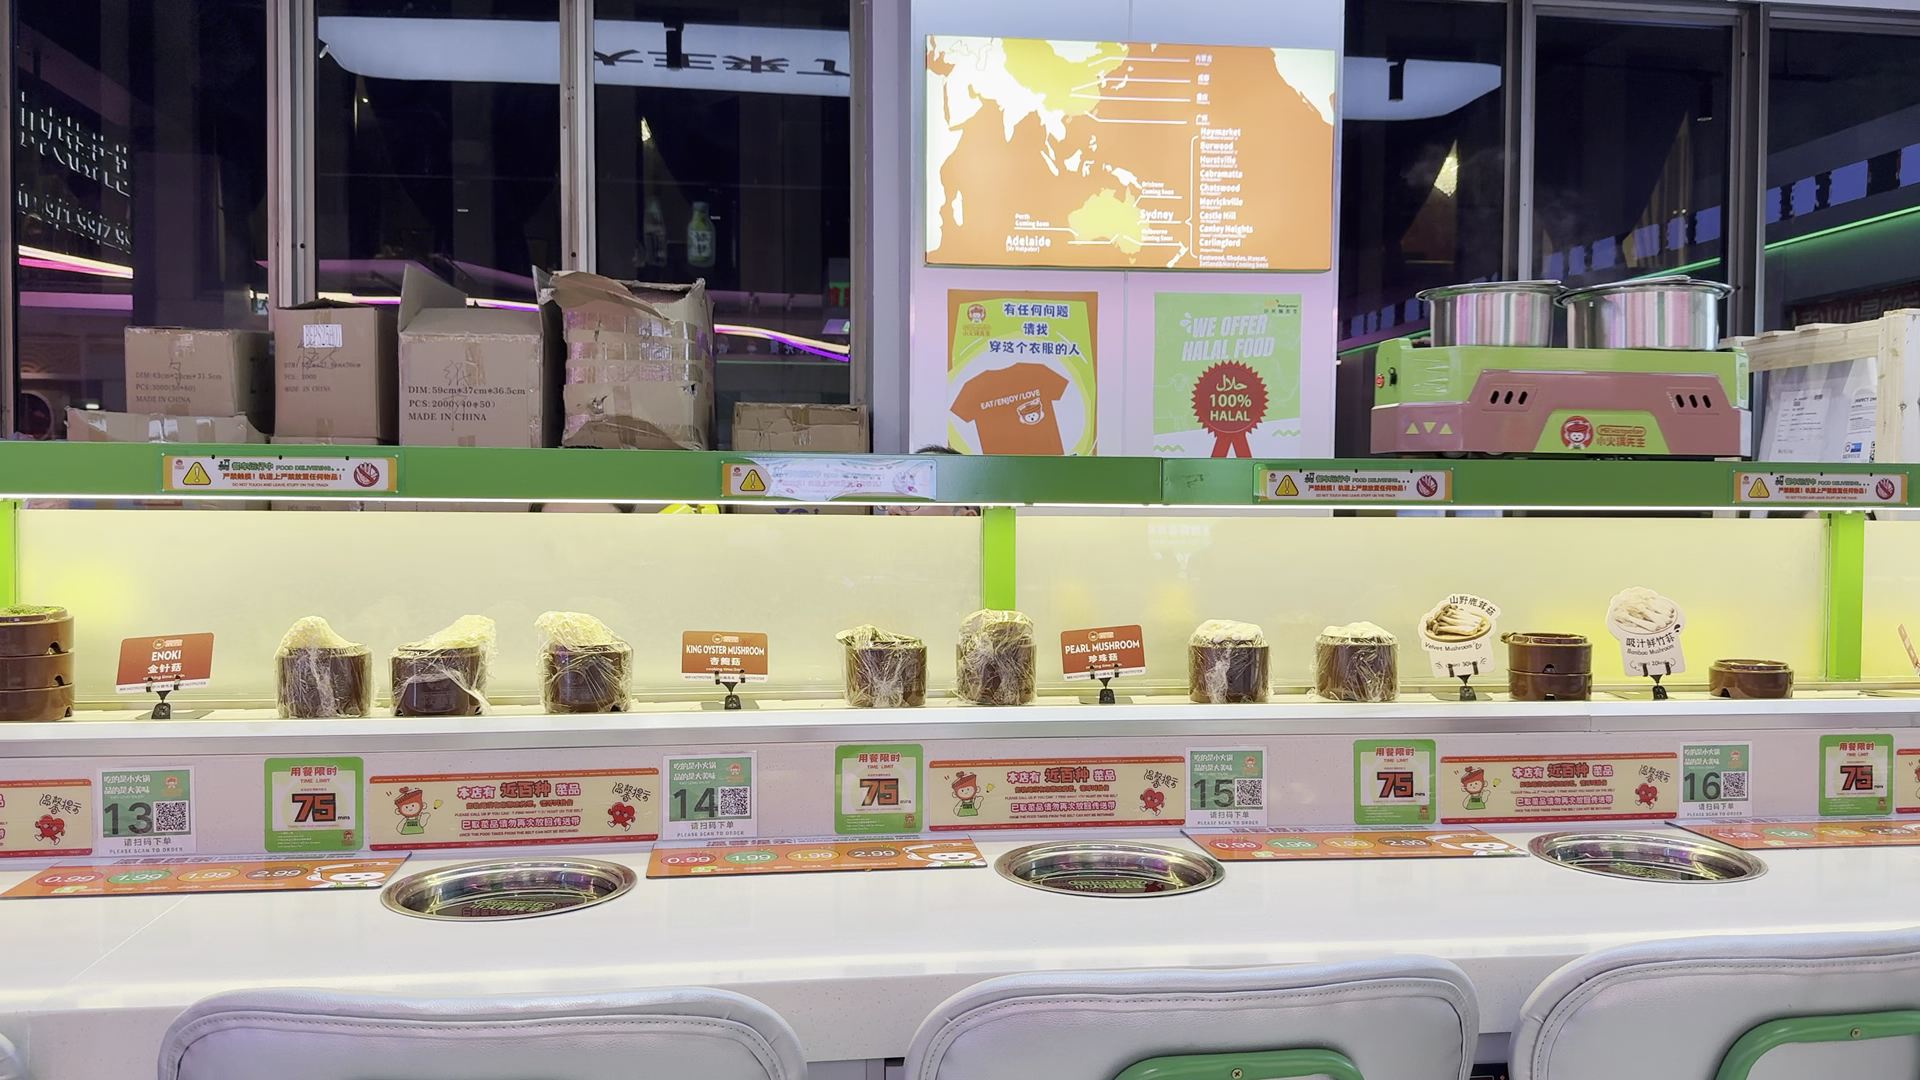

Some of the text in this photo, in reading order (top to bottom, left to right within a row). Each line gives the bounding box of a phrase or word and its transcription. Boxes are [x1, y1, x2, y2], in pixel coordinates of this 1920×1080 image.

[1200, 128, 1241, 138] Haymarket
[1200, 141, 1234, 150] Burwood
[1200, 155, 1236, 164] Hurstville
[1200, 169, 1243, 178] Cabramatta
[1142, 188, 1161, 196] Coming
[1200, 183, 1241, 192] Chatswood
[1200, 197, 1243, 206] Marrickville
[1140, 209, 1173, 221] Sydney
[1200, 211, 1236, 220] Castle Hill
[1015, 220, 1035, 228] Coming
[1199, 224, 1253, 234] Canley Heights
[1006, 235, 1051, 247] Adelaide
[1199, 238, 1241, 248] Carlingford
[1004, 303, 1069, 317] 有任何问题
[1023, 323, 1048, 335] 请找
[1193, 314, 1268, 337] WE OFFER
[989, 341, 1080, 355] 穿这个衣服的人
[1181, 337, 1275, 361] HALAL FOOD
[1216, 374, 1248, 391] حلال
[1210, 394, 1252, 407] 100%
[408, 413, 487, 421] MADE IN CHINA
[1210, 410, 1251, 421] HALAL
[1449, 595, 1496, 616] 山野鹿茸菇
[686, 644, 764, 656] KING OYSTER MUSHROOM
[1065, 640, 1140, 654] PEARL MUSHROOM
[1445, 644, 1473, 652] Mushroom
[1649, 644, 1675, 655] Mushroom
[151, 650, 182, 662] ENOKI
[1088, 653, 1118, 663] 珍珠菇
[1375, 748, 1415, 756] 用餐限时
[1839, 742, 1875, 751] 用餐限时
[859, 753, 900, 762] 用餐限时
[291, 766, 338, 776] 用餐限时
[1007, 766, 1116, 784] 本店有 近百种 菜品
[1512, 762, 1613, 779] 本店有 近百种 菜品
[1840, 765, 1873, 790] 75
[104, 785, 150, 795] 品的是大美味
[457, 780, 581, 799] 本店有 近百种 菜品
[1377, 772, 1413, 798] 75
[1683, 771, 1721, 801] 16
[859, 778, 899, 806] 75
[1194, 779, 1235, 808] 15
[292, 792, 336, 822] 75
[673, 787, 718, 819] 14
[1698, 802, 1734, 811] 请扫码下单
[104, 802, 153, 835] 13
[1210, 811, 1249, 819] 请扫码下单
[691, 821, 734, 830] 请扫码下单
[123, 837, 172, 847] 请扫码下单
[667, 849, 895, 864] 0.99 1.99 1.99 2.99
[44, 868, 302, 884] 0.99 1.99 1.99 2.99
